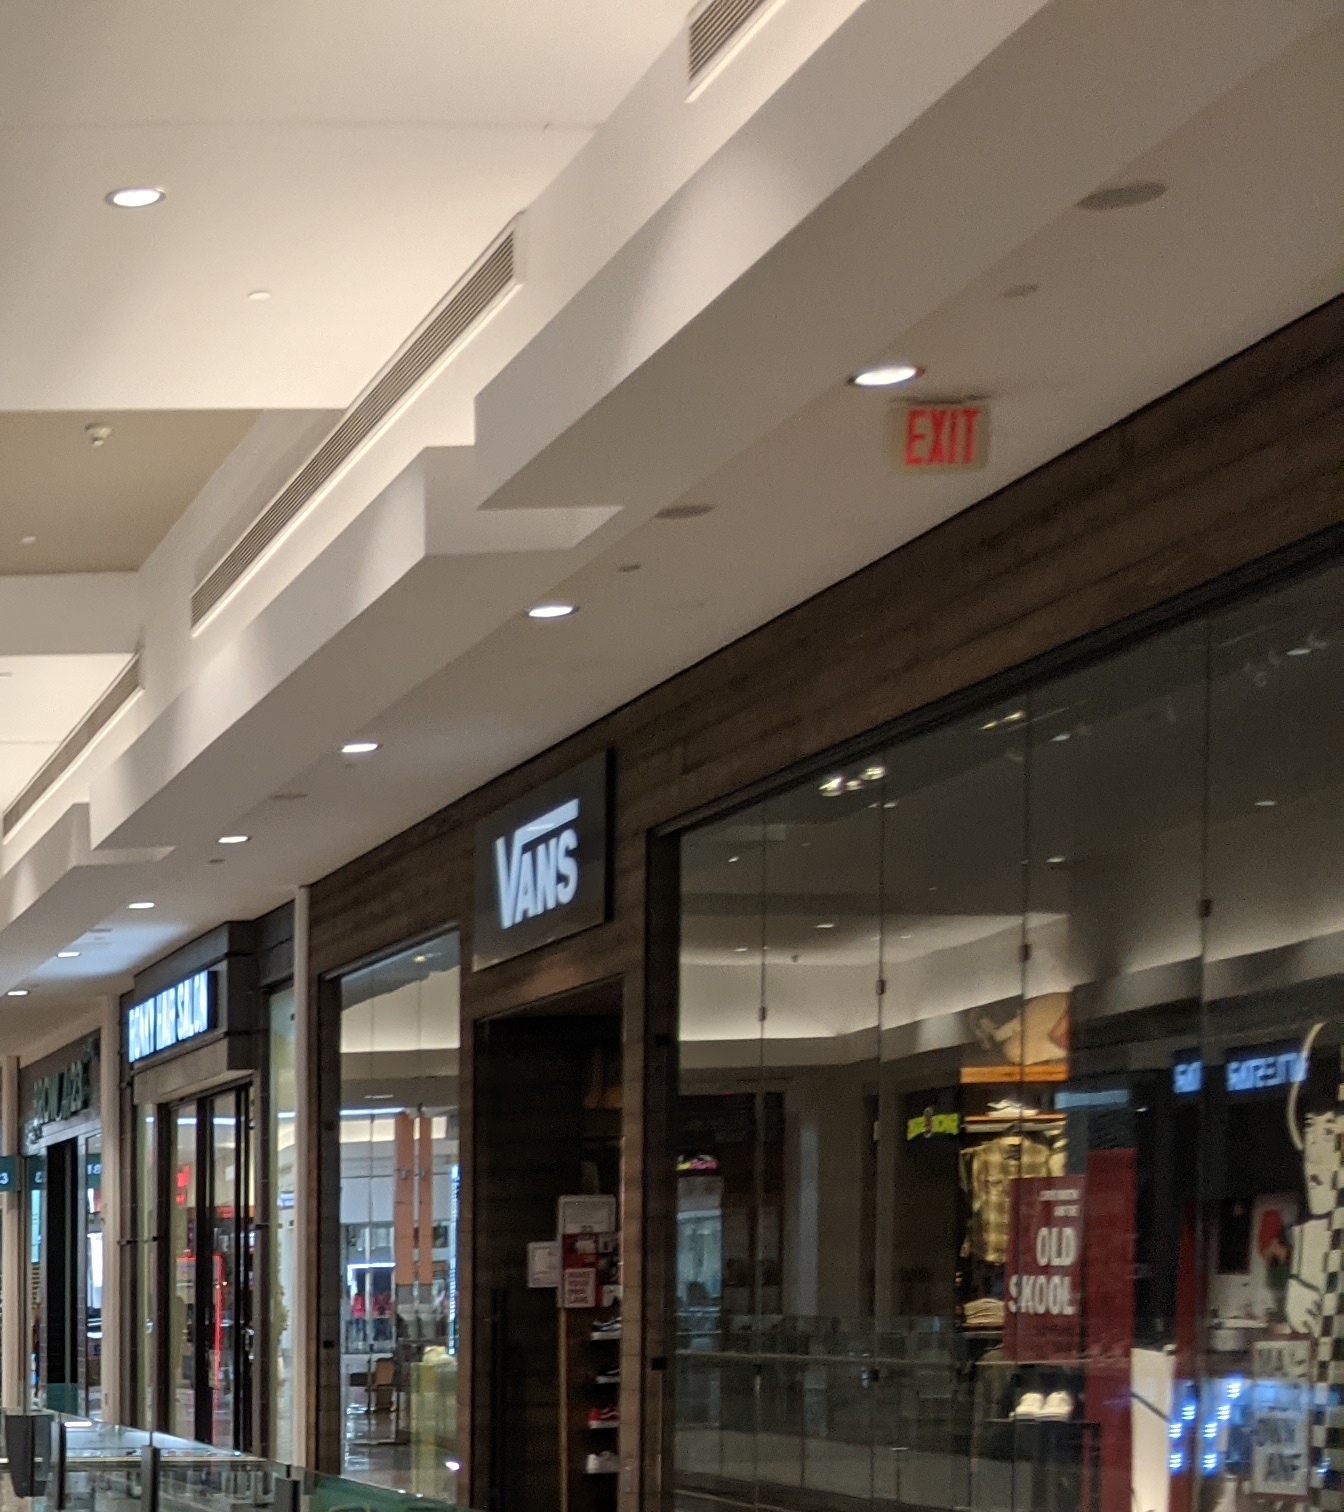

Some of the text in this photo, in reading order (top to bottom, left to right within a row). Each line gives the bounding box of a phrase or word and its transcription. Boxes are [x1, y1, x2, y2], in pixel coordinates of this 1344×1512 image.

[906, 407, 980, 466] EXIT
[495, 798, 579, 930] VANS
[1036, 1227, 1077, 1267] OLD
[1008, 1274, 1076, 1315] SKOOL
